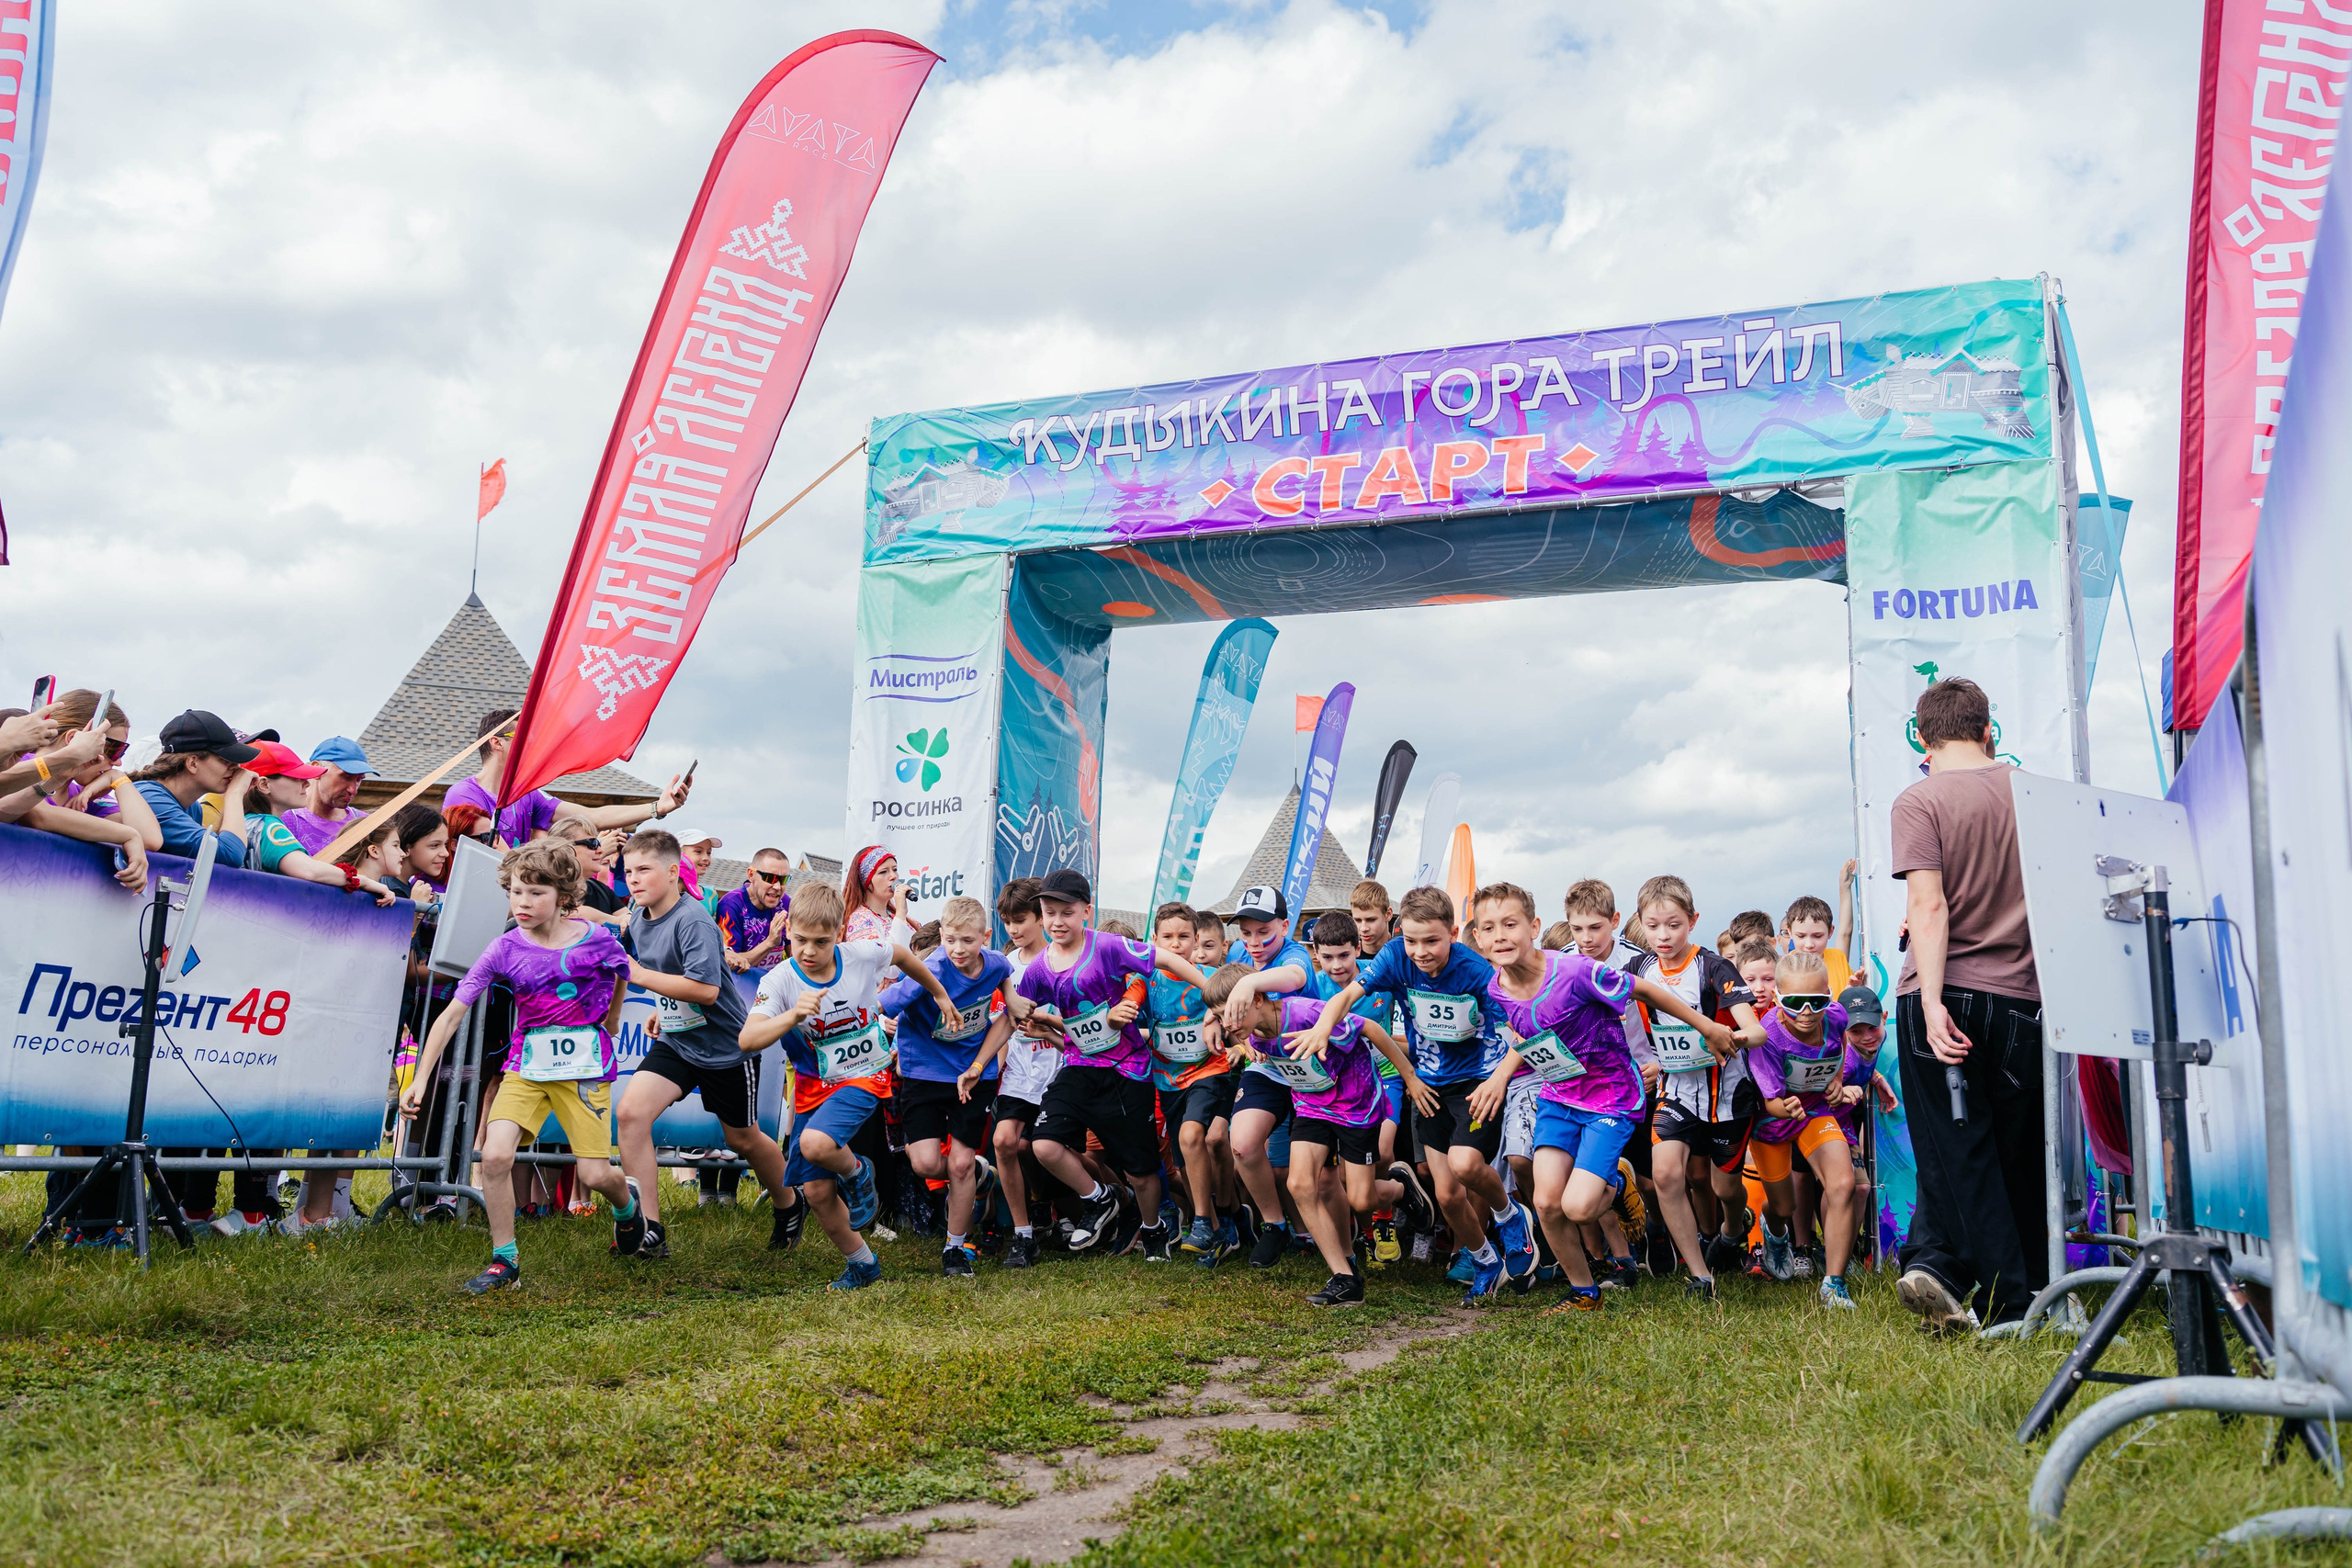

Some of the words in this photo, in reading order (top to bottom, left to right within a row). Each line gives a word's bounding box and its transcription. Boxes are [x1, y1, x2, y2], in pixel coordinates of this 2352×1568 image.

[792, 141, 829, 161] RACE
[1008, 379, 1383, 473] КУДЫКИНА
[1400, 355, 1580, 427] ГОРА
[1589, 317, 1846, 412] ТРЕЙЛ
[1250, 433, 1547, 518] СТАРТ
[1872, 579, 2039, 621] FORTUNA
[869, 666, 978, 691] Мистраль
[871, 795, 963, 822] росинка
[926, 820, 951, 830] природы
[660, 997, 678, 1011] 98
[1429, 1004, 1454, 1021] 35
[963, 1009, 981, 1024] 88
[1070, 1020, 1102, 1039] 140
[1165, 1030, 1197, 1045] 105
[549, 1037, 576, 1056] 10
[1084, 1036, 1101, 1044] САВВА
[1658, 1036, 1690, 1051] 116
[194, 1047, 278, 1068] подарки
[834, 1039, 873, 1065] 200
[1523, 1047, 1555, 1066] 133
[843, 1057, 869, 1071] ГЕОРГИЙ
[1278, 1065, 1307, 1076] 158
[1804, 1064, 1838, 1078] 125
